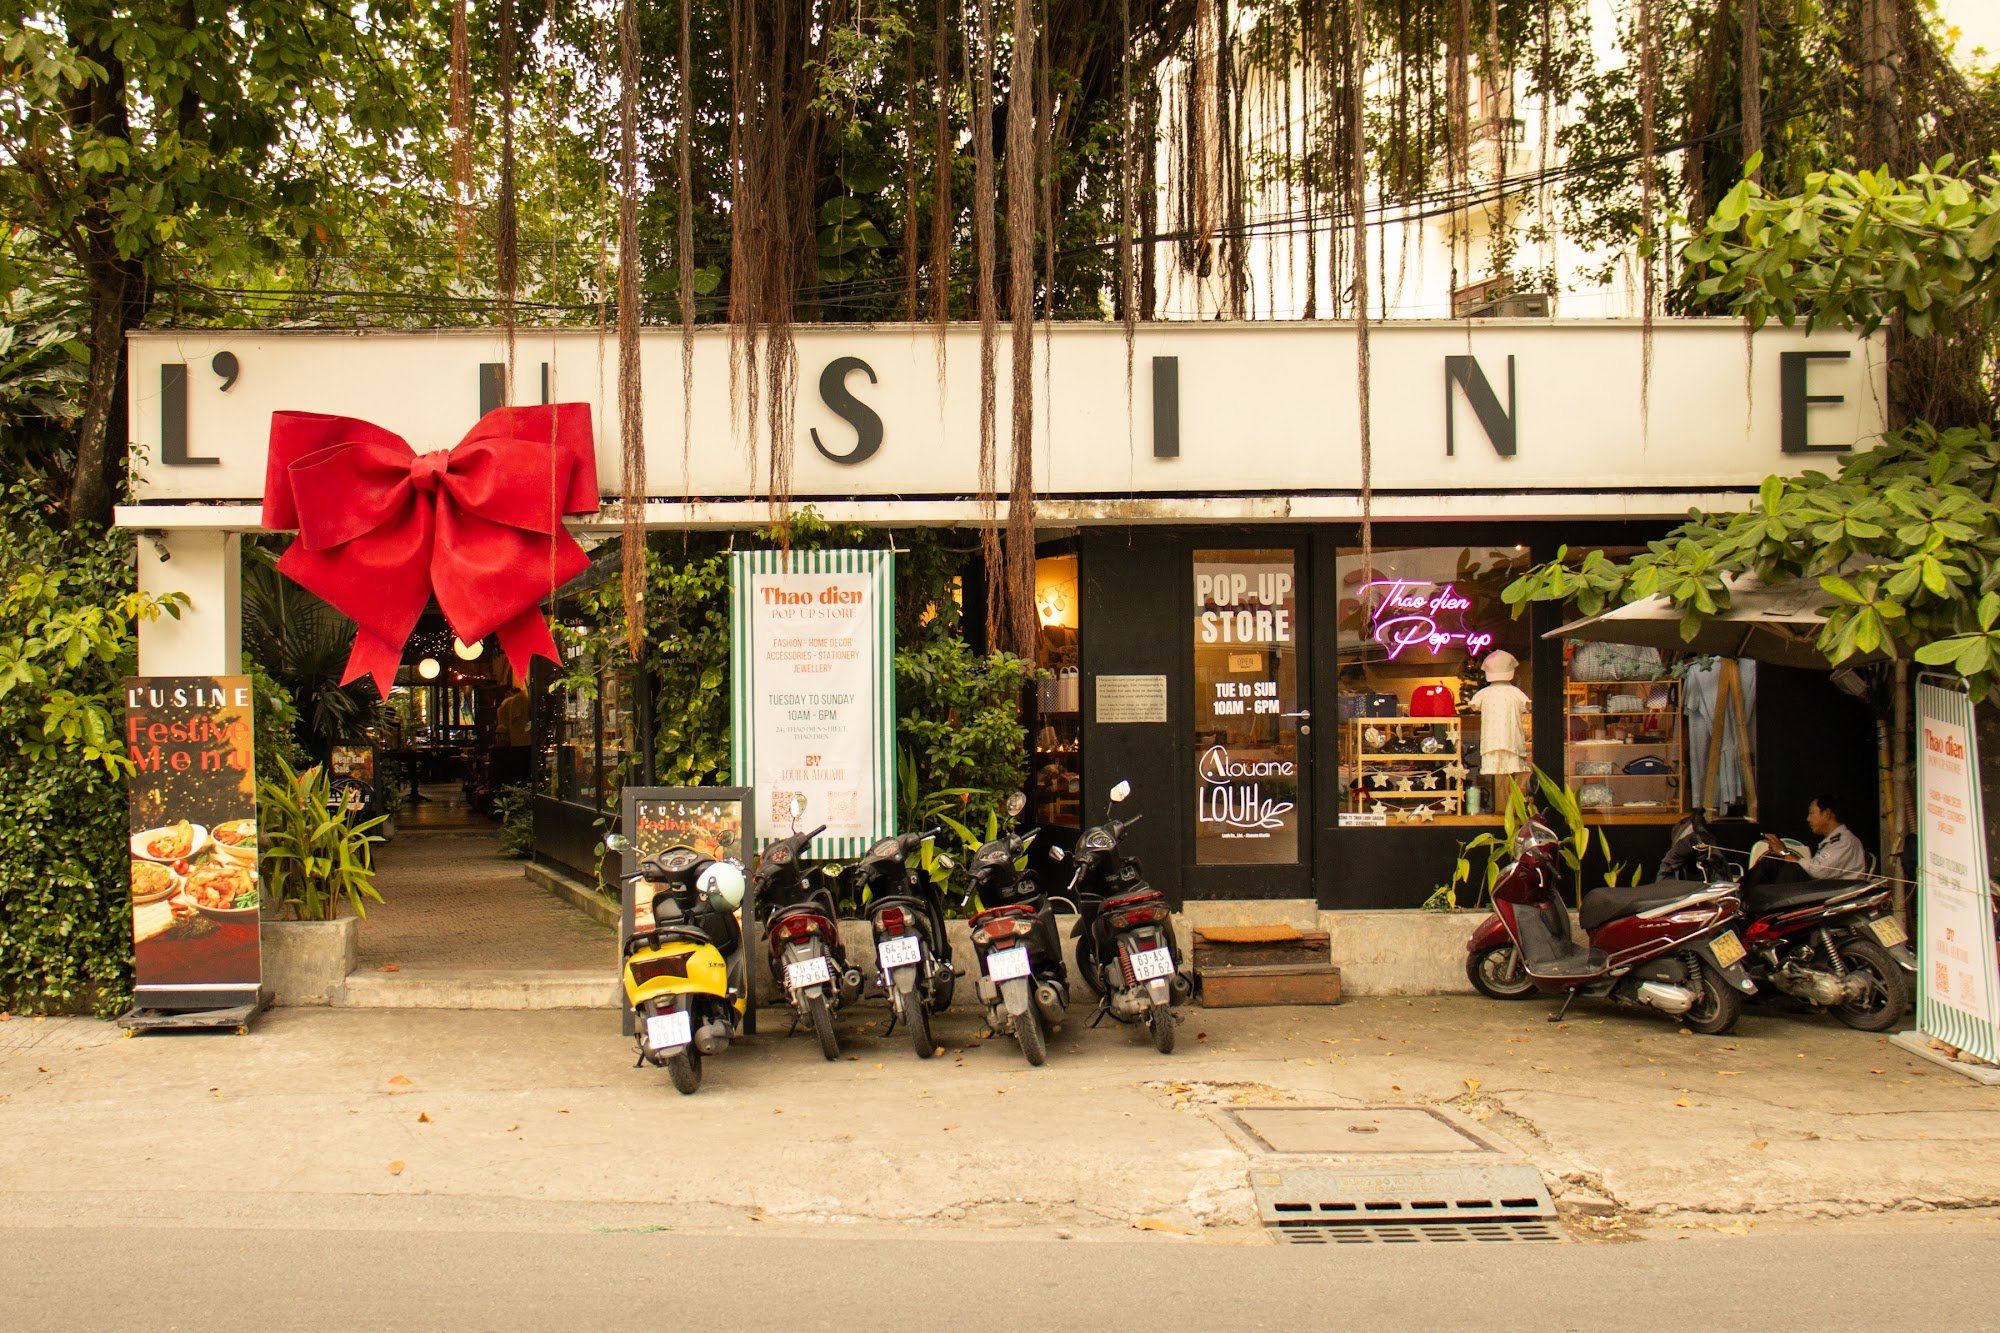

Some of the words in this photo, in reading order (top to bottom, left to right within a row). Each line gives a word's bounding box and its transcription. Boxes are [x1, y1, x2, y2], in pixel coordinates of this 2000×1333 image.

[761, 587, 813, 605] Thao
[819, 586, 863, 605] dien
[1196, 573, 1292, 607] POP-UP
[1357, 577, 1430, 620] Thao
[1429, 584, 1471, 616] dien
[772, 608, 795, 619] POP
[818, 608, 857, 619] STORE
[1201, 610, 1290, 643] STORE
[773, 638, 802, 648] FASHION
[808, 638, 828, 648] HOME
[829, 638, 853, 648] DECOR
[1375, 615, 1493, 660] Pop-up
[766, 652, 812, 661] ACCESSORIES
[818, 651, 859, 661] STATIONERY
[793, 664, 832, 673] JEWELLERY
[128, 687, 249, 708] L'USINE
[1216, 683, 1236, 697] TUE
[1239, 683, 1251, 697] to
[1254, 682, 1276, 697] SUN
[769, 694, 806, 706] TUESDAY
[809, 694, 819, 706] TO
[821, 694, 855, 705] SUNDAY
[1213, 700, 1244, 715] 10AM
[1254, 699, 1280, 714] 6PM
[788, 710, 811, 721] 10AM
[818, 710, 837, 721] 6PM
[129, 716, 250, 743] Festive
[1925, 729, 1943, 754] Thao
[1946, 735, 1964, 760] dien
[129, 745, 251, 770] Menu
[352, 756, 364, 764] End
[334, 764, 350, 773] Sale
[1199, 783, 1258, 822] LOUH
[639, 818, 692, 831] Festive
